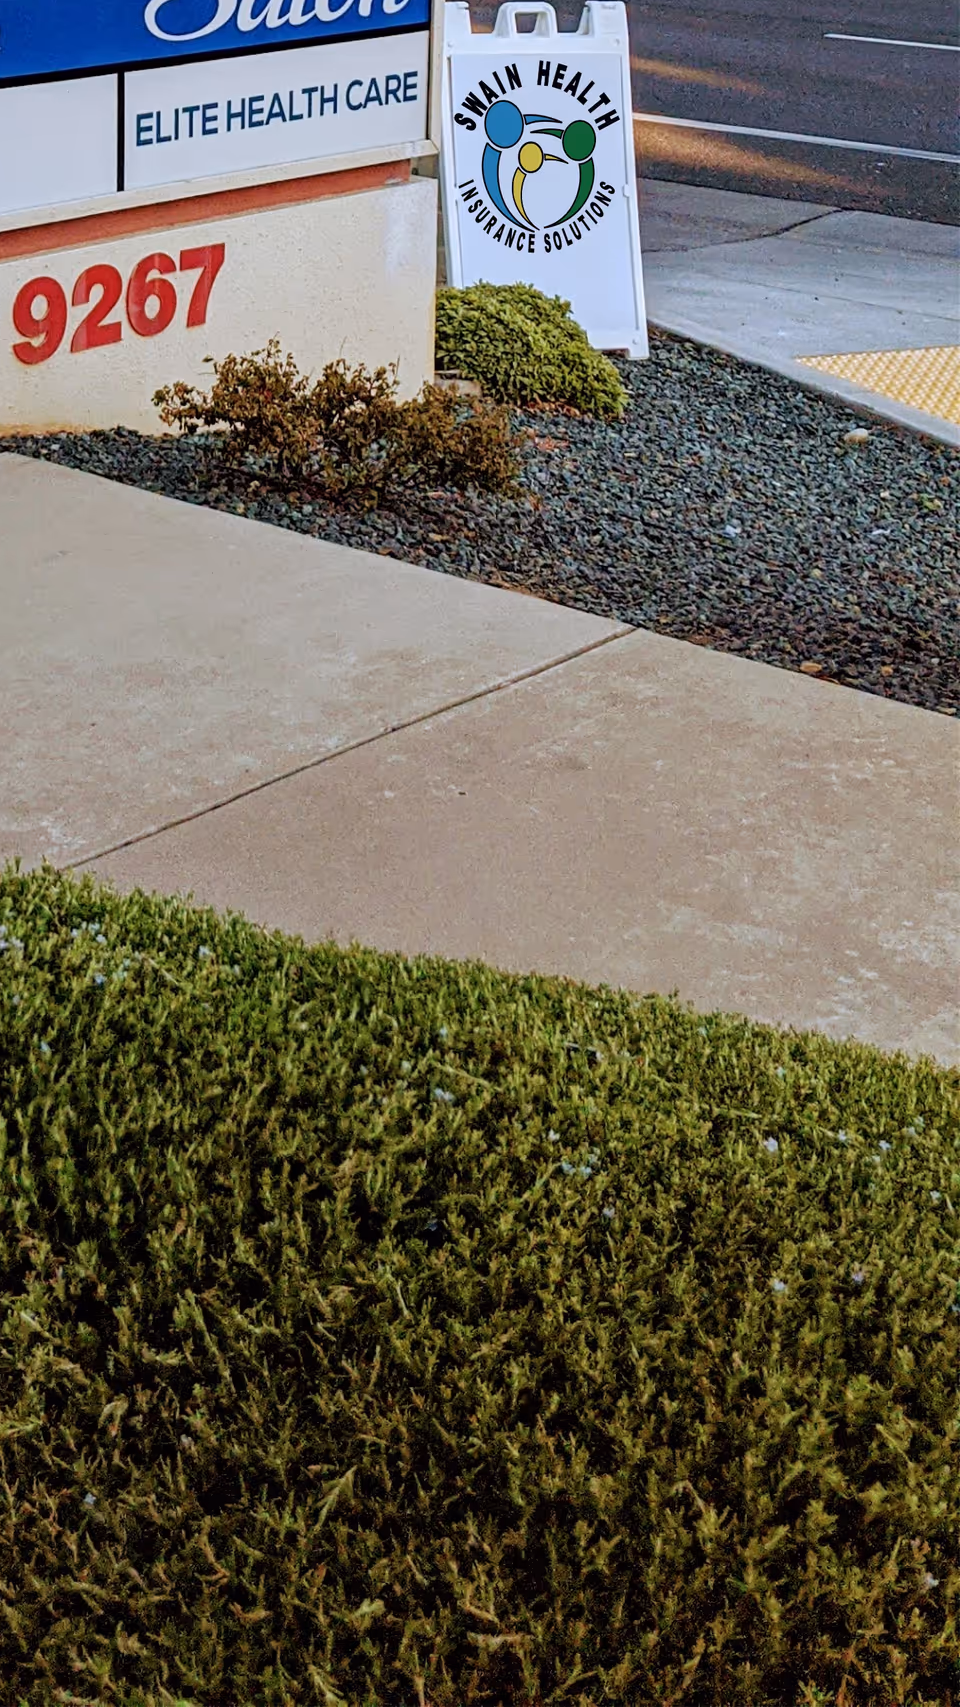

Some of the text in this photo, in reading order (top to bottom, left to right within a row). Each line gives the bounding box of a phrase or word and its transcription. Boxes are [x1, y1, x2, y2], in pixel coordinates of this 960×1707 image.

[135, 70, 420, 148] ELITE HEALTH CARE
[453, 59, 622, 133] SWAIN HEALTH
[458, 179, 617, 254] INSURANCE SOLUTIONS
[11, 242, 227, 368] 9267
